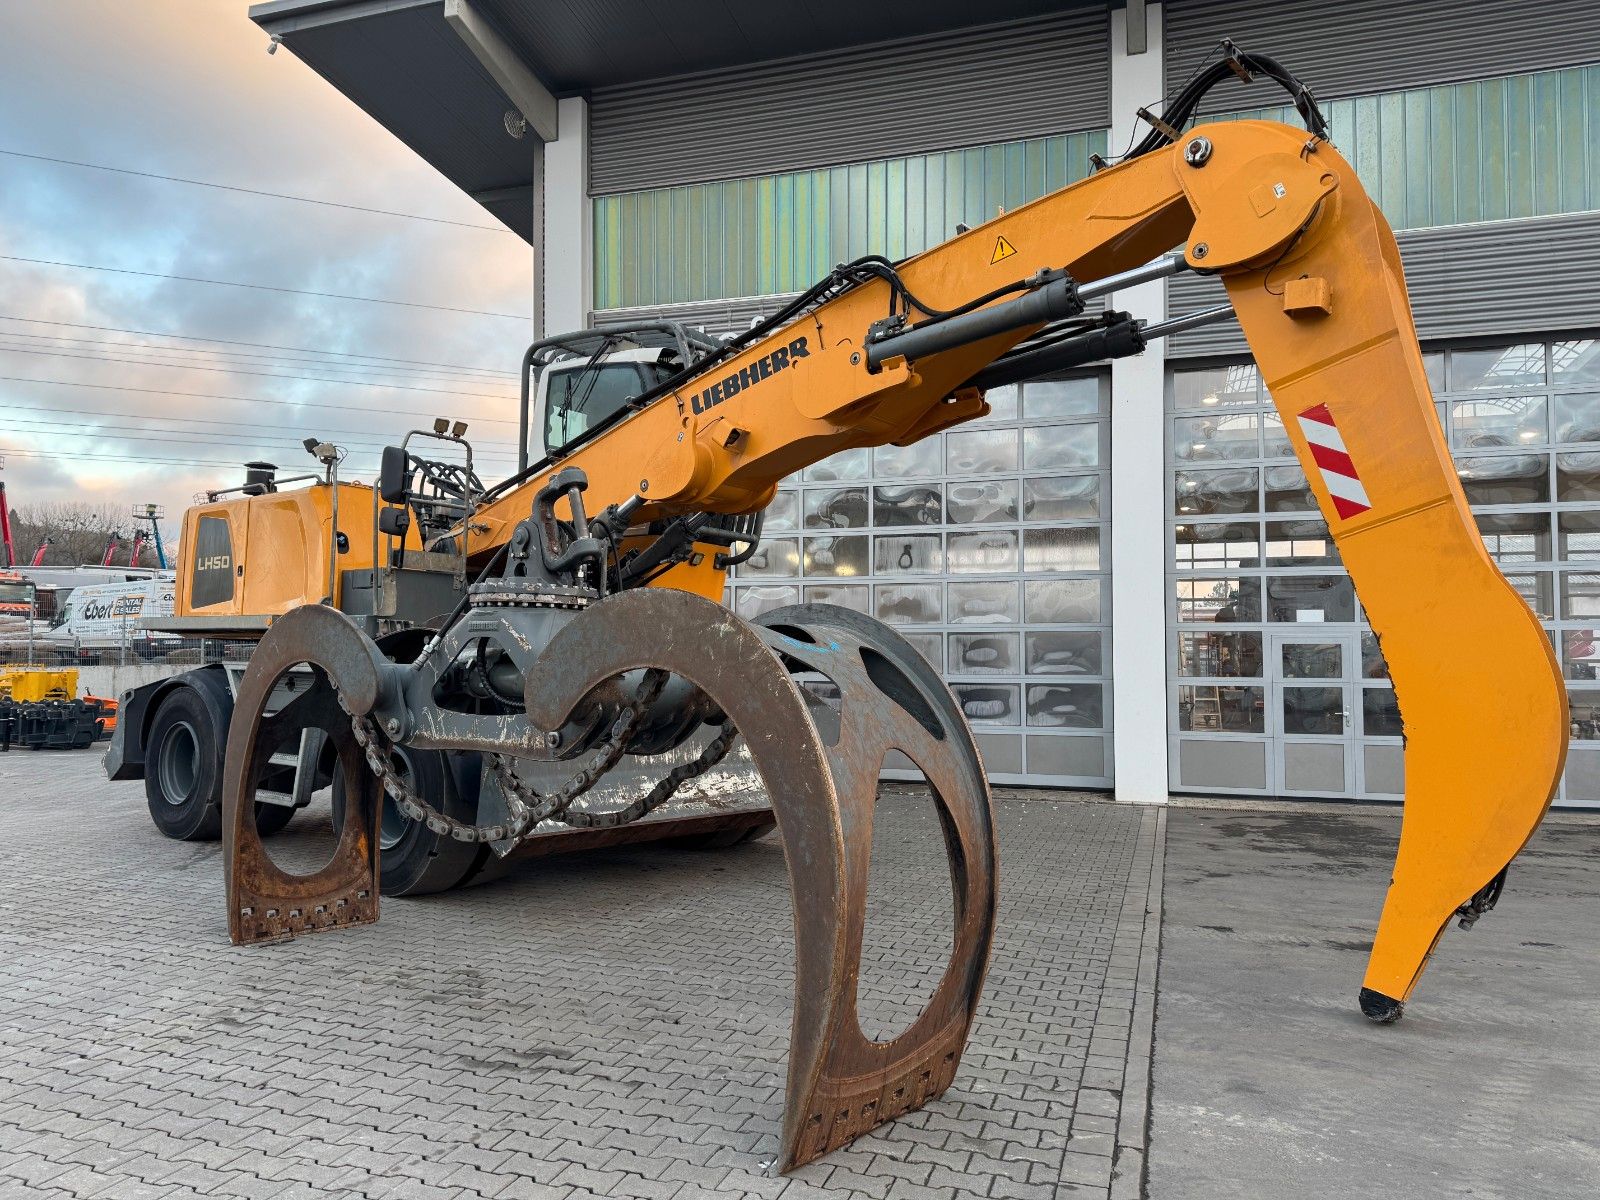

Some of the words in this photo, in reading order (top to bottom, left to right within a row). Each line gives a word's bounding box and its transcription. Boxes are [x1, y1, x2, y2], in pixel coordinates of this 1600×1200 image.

[690, 336, 811, 416] LIEBHERR
[197, 555, 230, 571] LH50
[84, 599, 114, 620] Ebert
